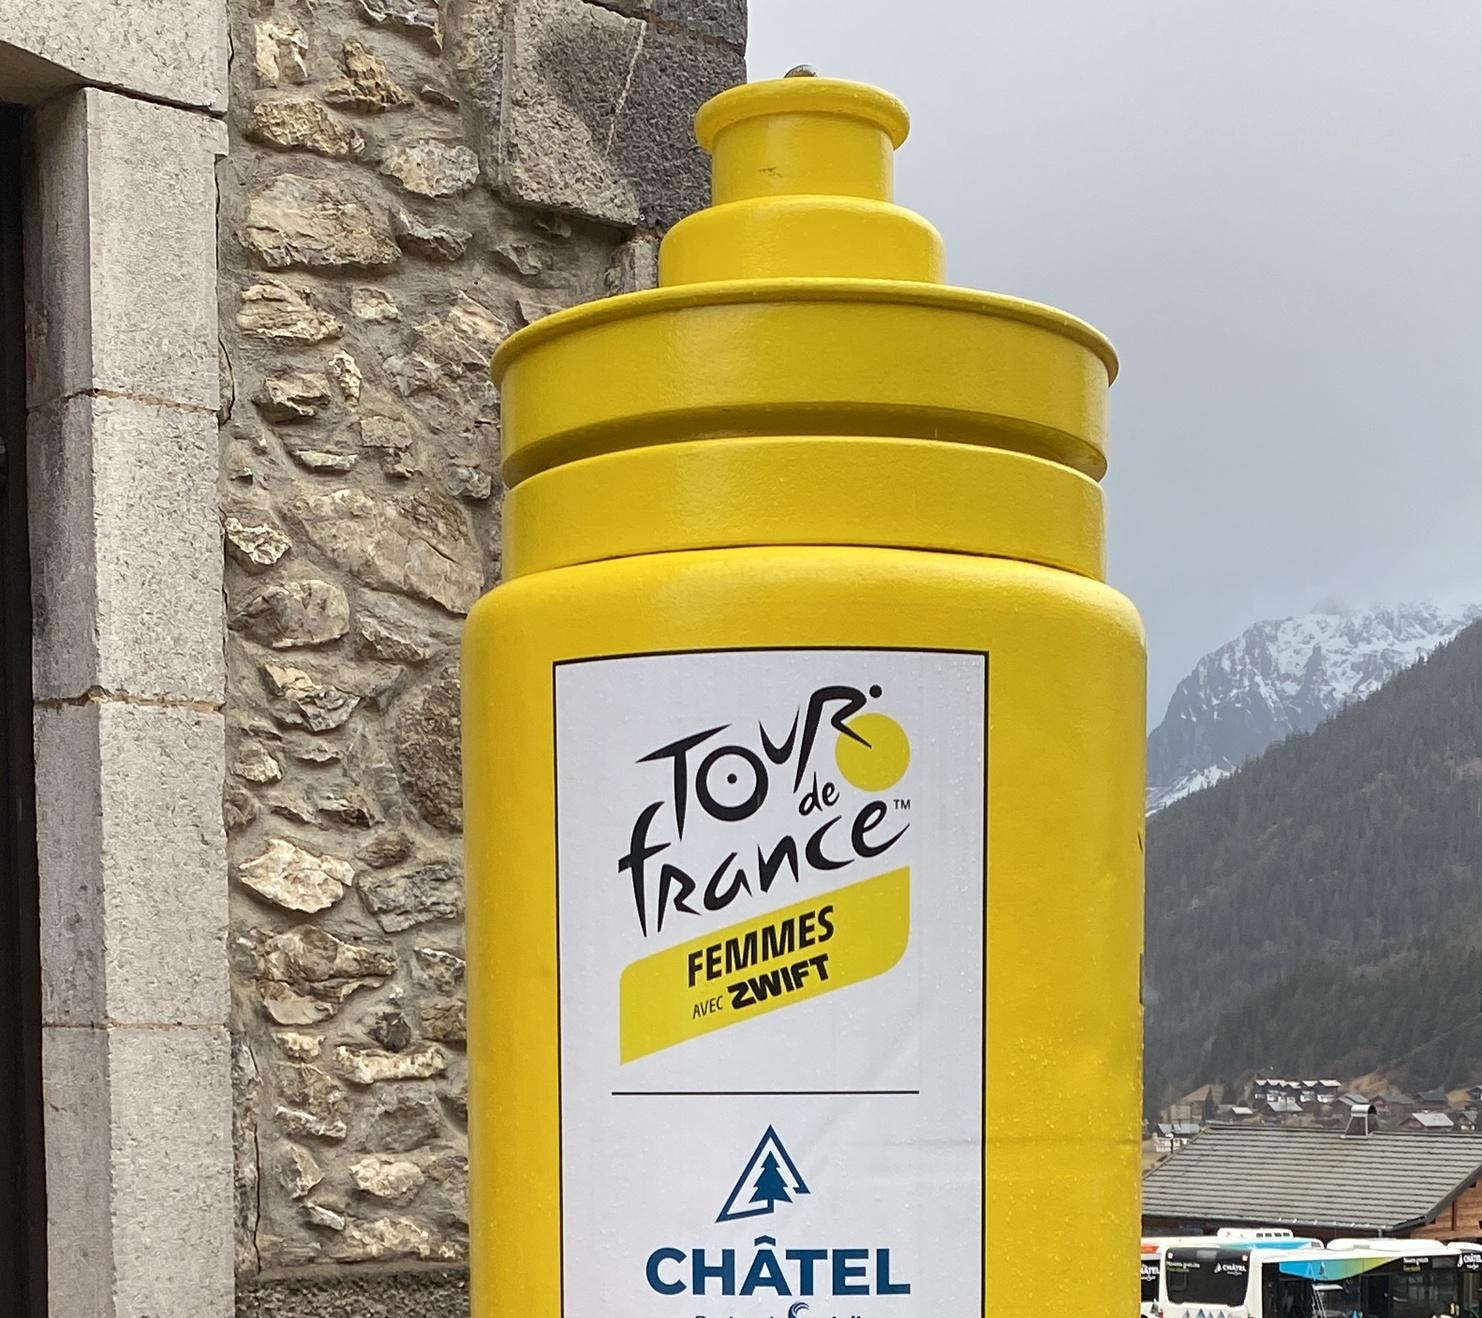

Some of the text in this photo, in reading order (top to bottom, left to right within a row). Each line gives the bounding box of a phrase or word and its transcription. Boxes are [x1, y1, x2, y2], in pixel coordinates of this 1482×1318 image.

[798, 771, 840, 817] de
[687, 904, 835, 988] FEMMES
[692, 953, 830, 1020] AVEC ZWIFT
[645, 1234, 912, 1297] CHÂTEL
